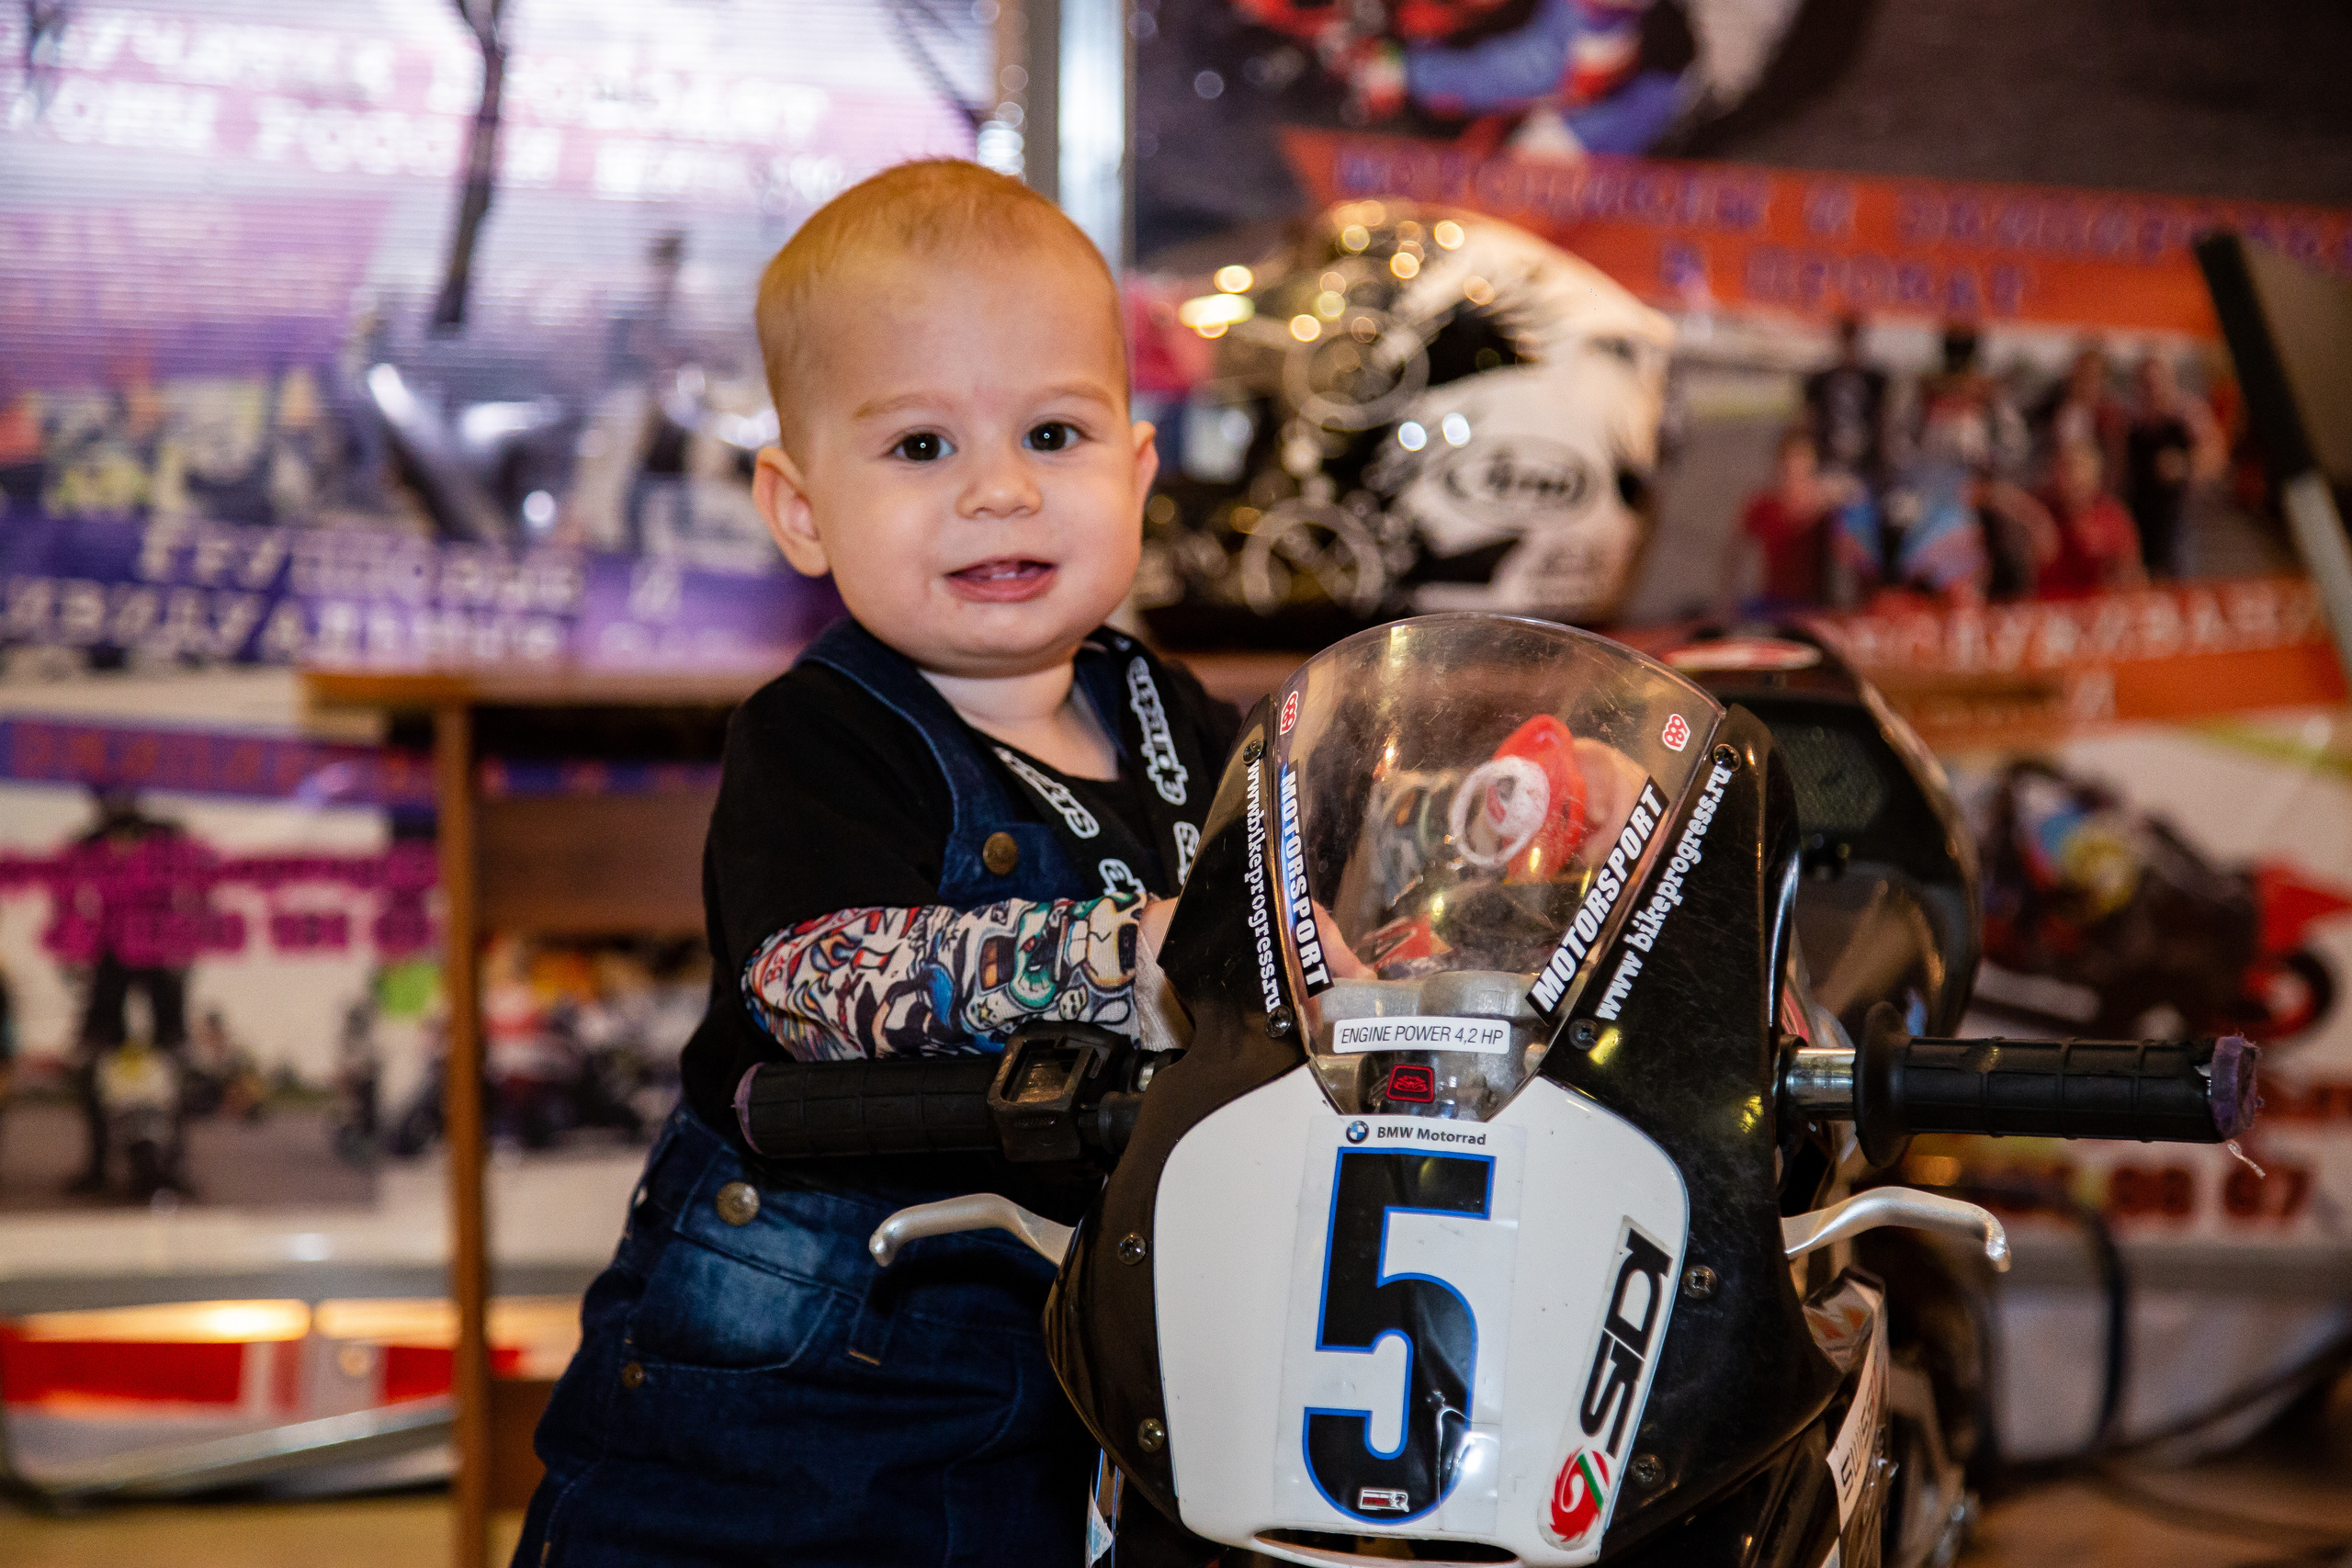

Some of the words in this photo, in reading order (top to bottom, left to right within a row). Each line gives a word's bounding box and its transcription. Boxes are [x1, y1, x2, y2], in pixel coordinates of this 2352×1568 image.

[1282, 770, 1329, 986] MOTORSPORT
[1530, 784, 1663, 1012] MOTORSPORT
[1340, 1025, 1393, 1044] ENGINE
[1394, 1025, 1452, 1043] POWER
[1454, 1027, 1478, 1044] 4,2
[1481, 1028, 1504, 1045] HP
[1376, 1126, 1414, 1139] BMW
[1417, 1127, 1487, 1145] Motorrad
[1302, 1145, 1498, 1527] 5
